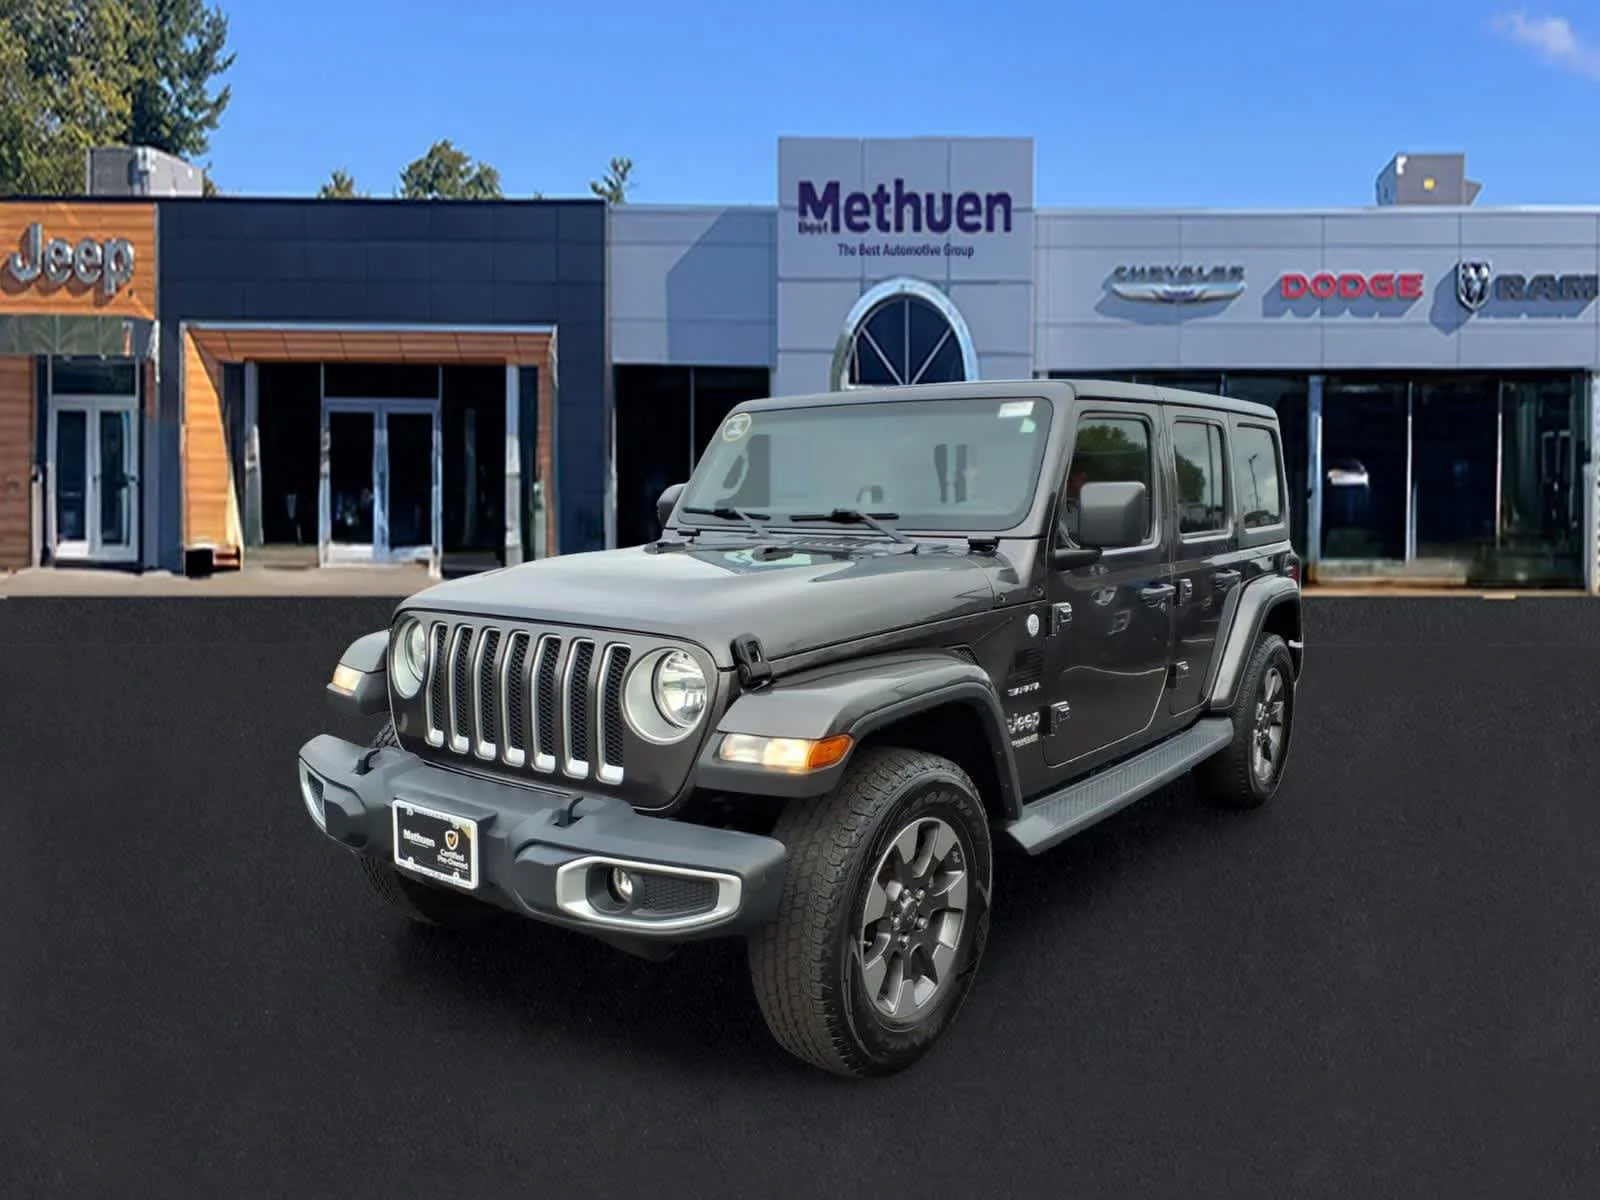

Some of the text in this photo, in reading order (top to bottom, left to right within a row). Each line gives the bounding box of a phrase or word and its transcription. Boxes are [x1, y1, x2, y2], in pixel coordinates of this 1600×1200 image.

[798, 178, 1012, 233] Methuen
[798, 221, 828, 234] Best
[9, 222, 135, 296] Jeep
[838, 243, 974, 259] The Best Automotive Group
[1281, 273, 1424, 298] DODGE
[1495, 274, 1600, 299] RAM
